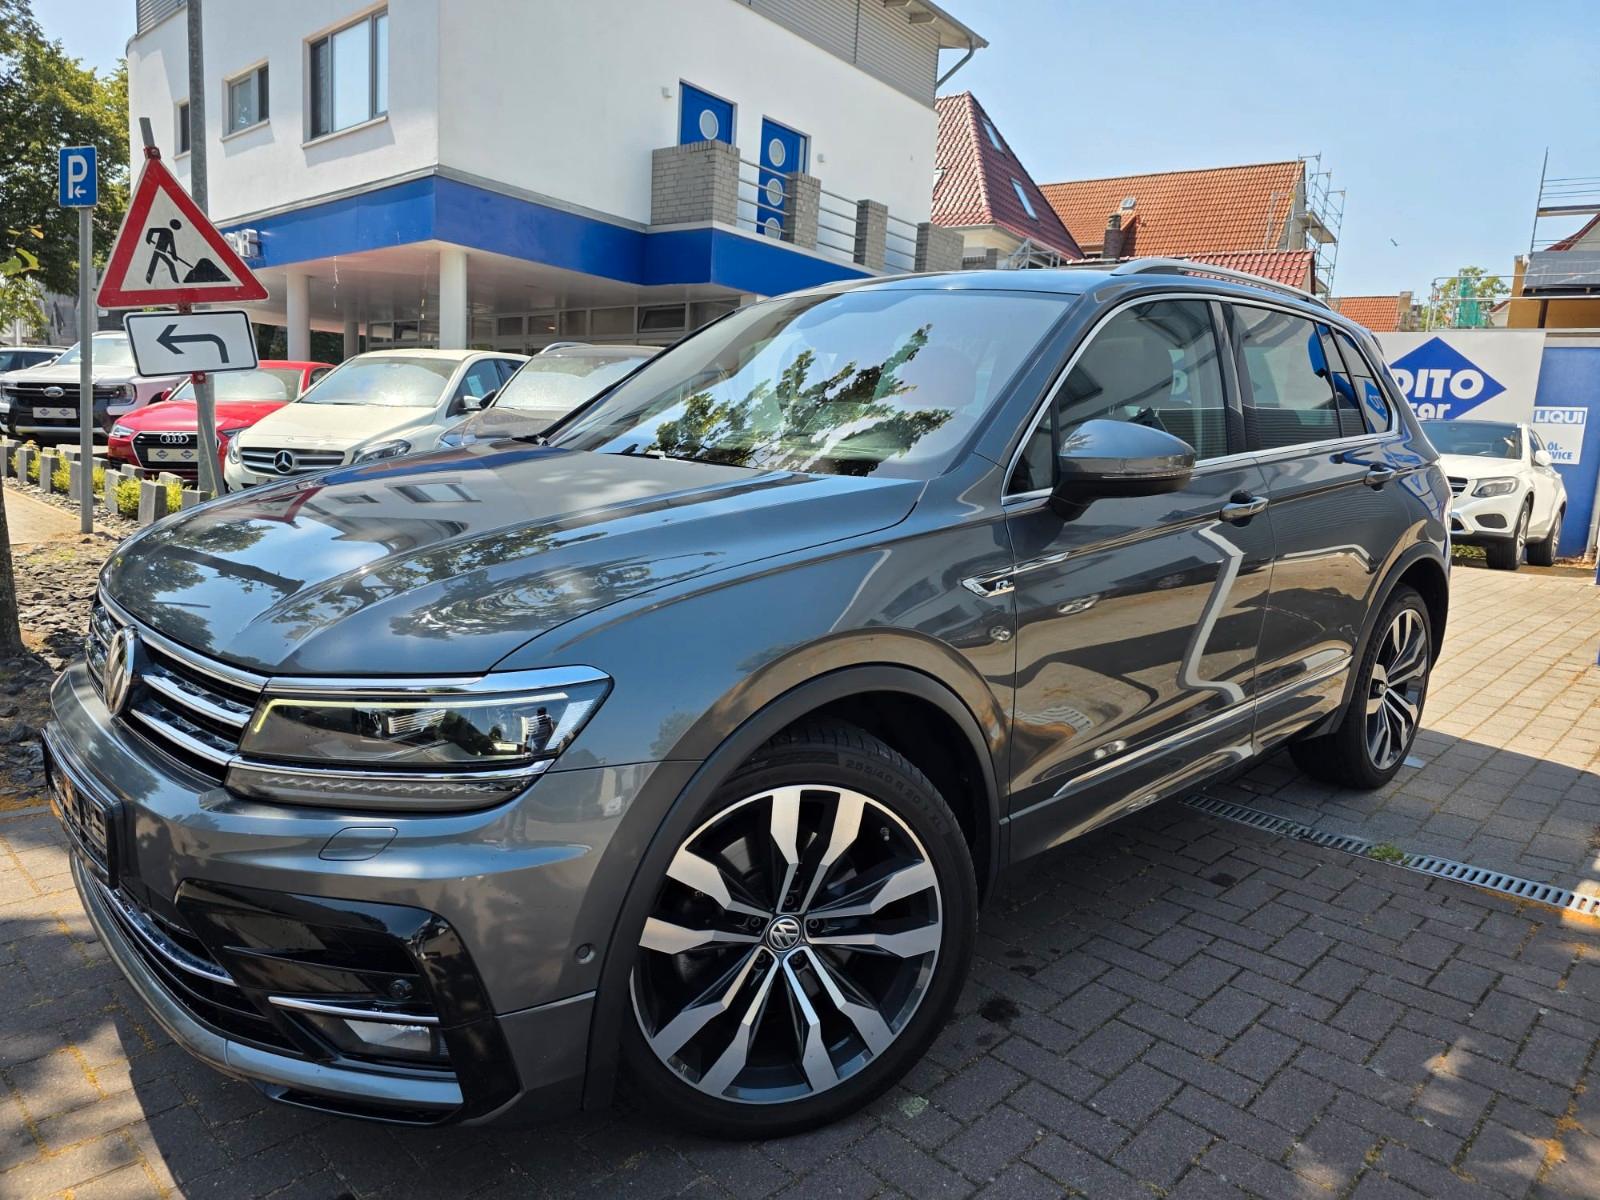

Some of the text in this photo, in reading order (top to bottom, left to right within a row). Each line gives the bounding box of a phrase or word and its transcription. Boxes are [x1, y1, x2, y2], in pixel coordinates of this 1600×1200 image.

[68, 155, 87, 199] P
[1390, 368, 1485, 400] DITO
[1535, 411, 1584, 424] LIQUI
